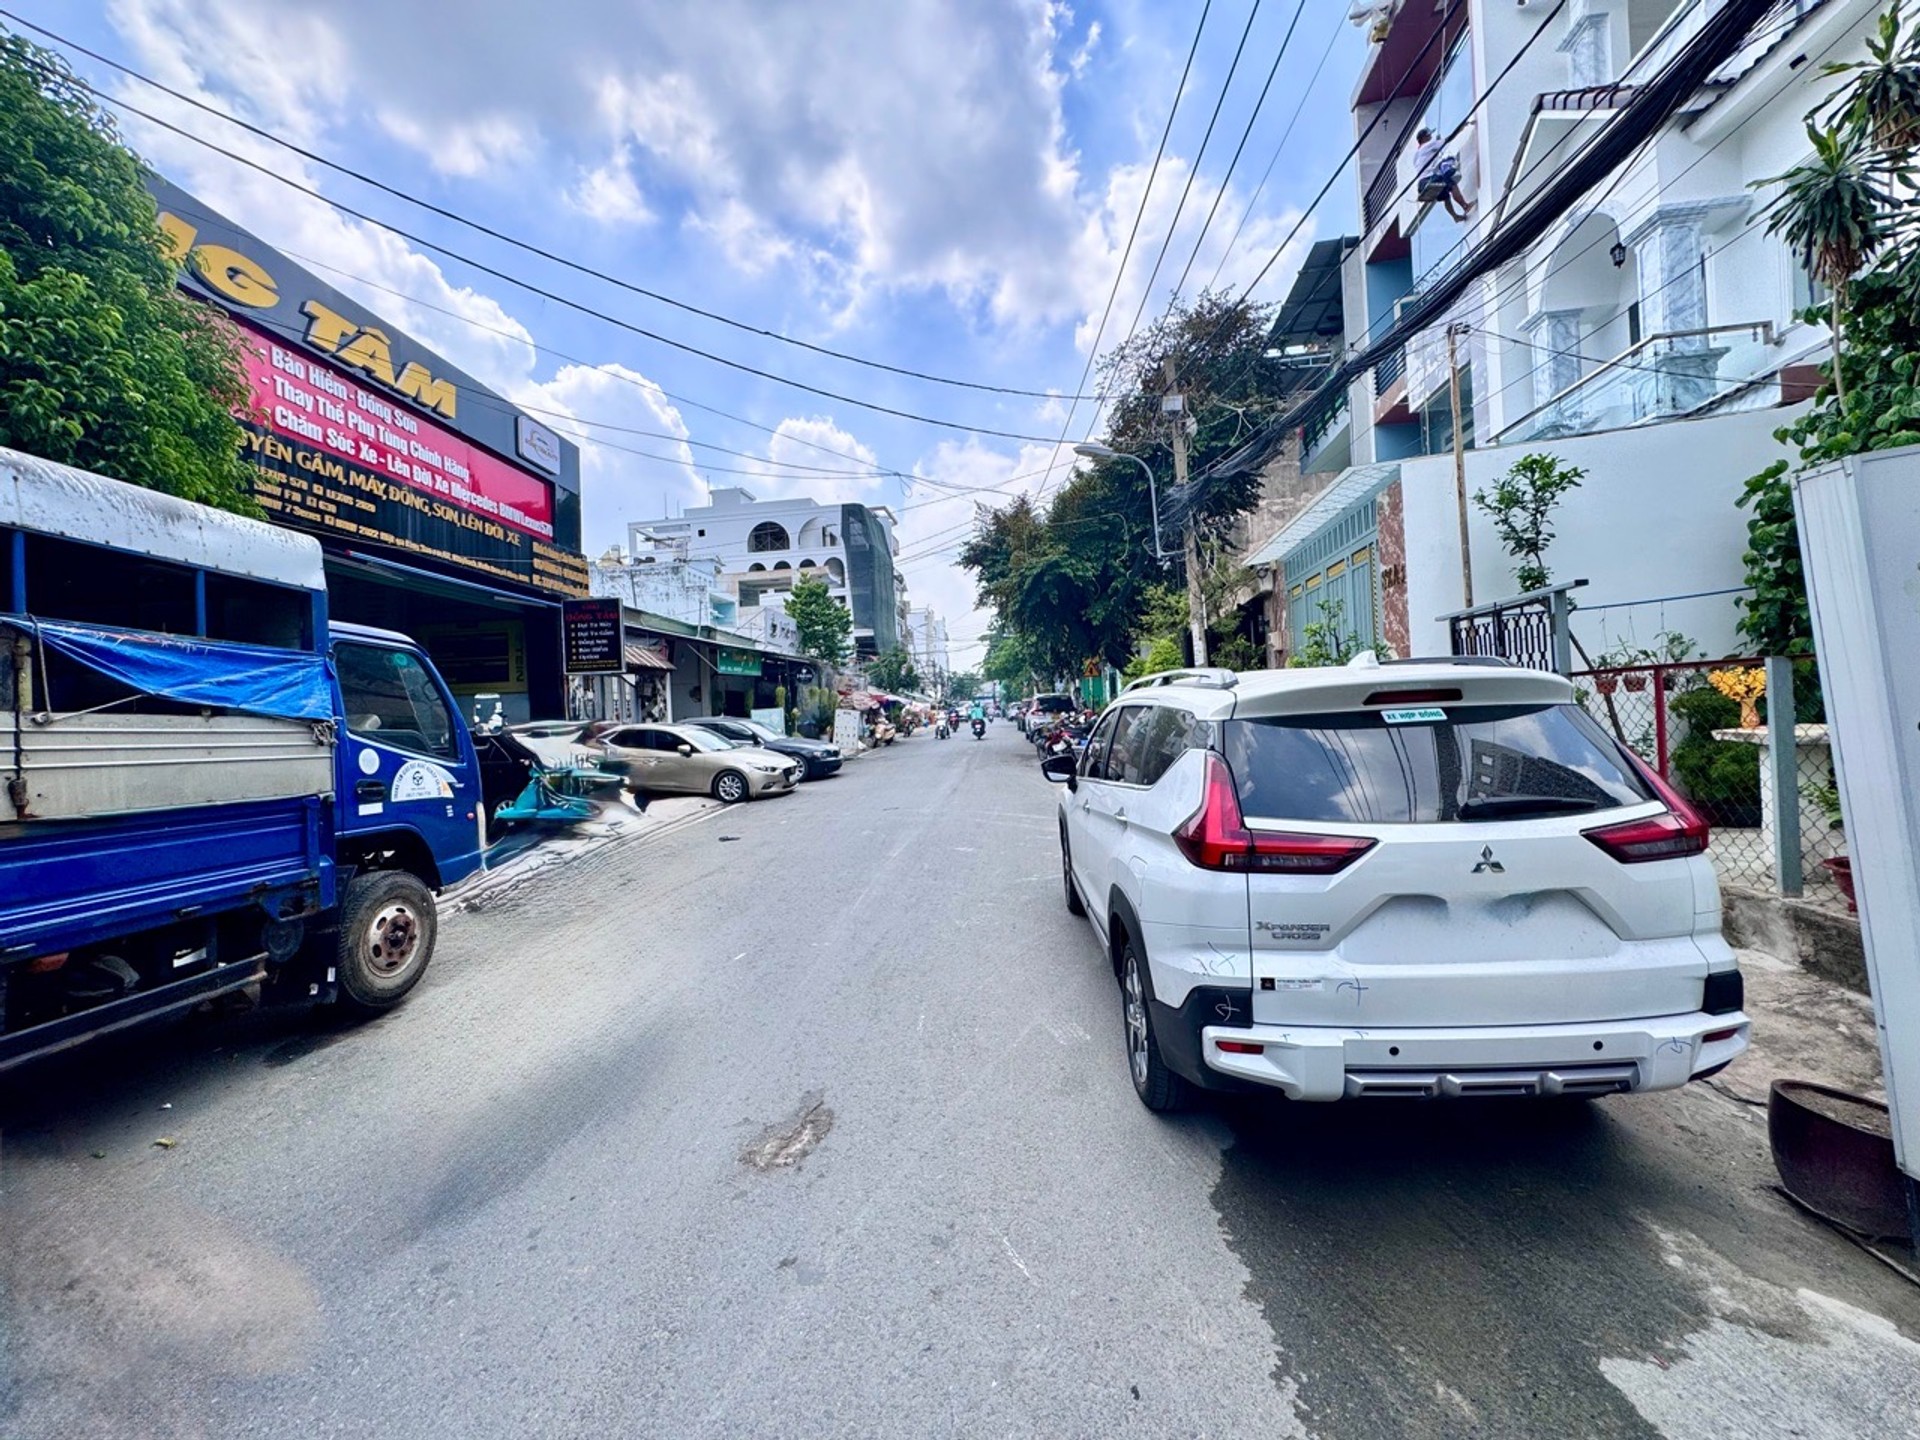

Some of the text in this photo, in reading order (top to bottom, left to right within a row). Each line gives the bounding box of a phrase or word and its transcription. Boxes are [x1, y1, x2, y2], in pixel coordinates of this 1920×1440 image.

[271, 346, 305, 380] Bảo
[308, 364, 348, 401] Hiểm
[393, 409, 418, 435] Sơn
[301, 300, 456, 419] TÂM
[273, 375, 315, 413] Thay
[316, 395, 345, 425] Thế
[347, 410, 375, 442] Phụ
[274, 404, 323, 443] Chăm
[326, 426, 356, 456] Sóc
[358, 440, 378, 465] Xe
[434, 473, 450, 494] Xe
[1255, 920, 1331, 932] XPANDER
[1271, 932, 1322, 940] CROSS
